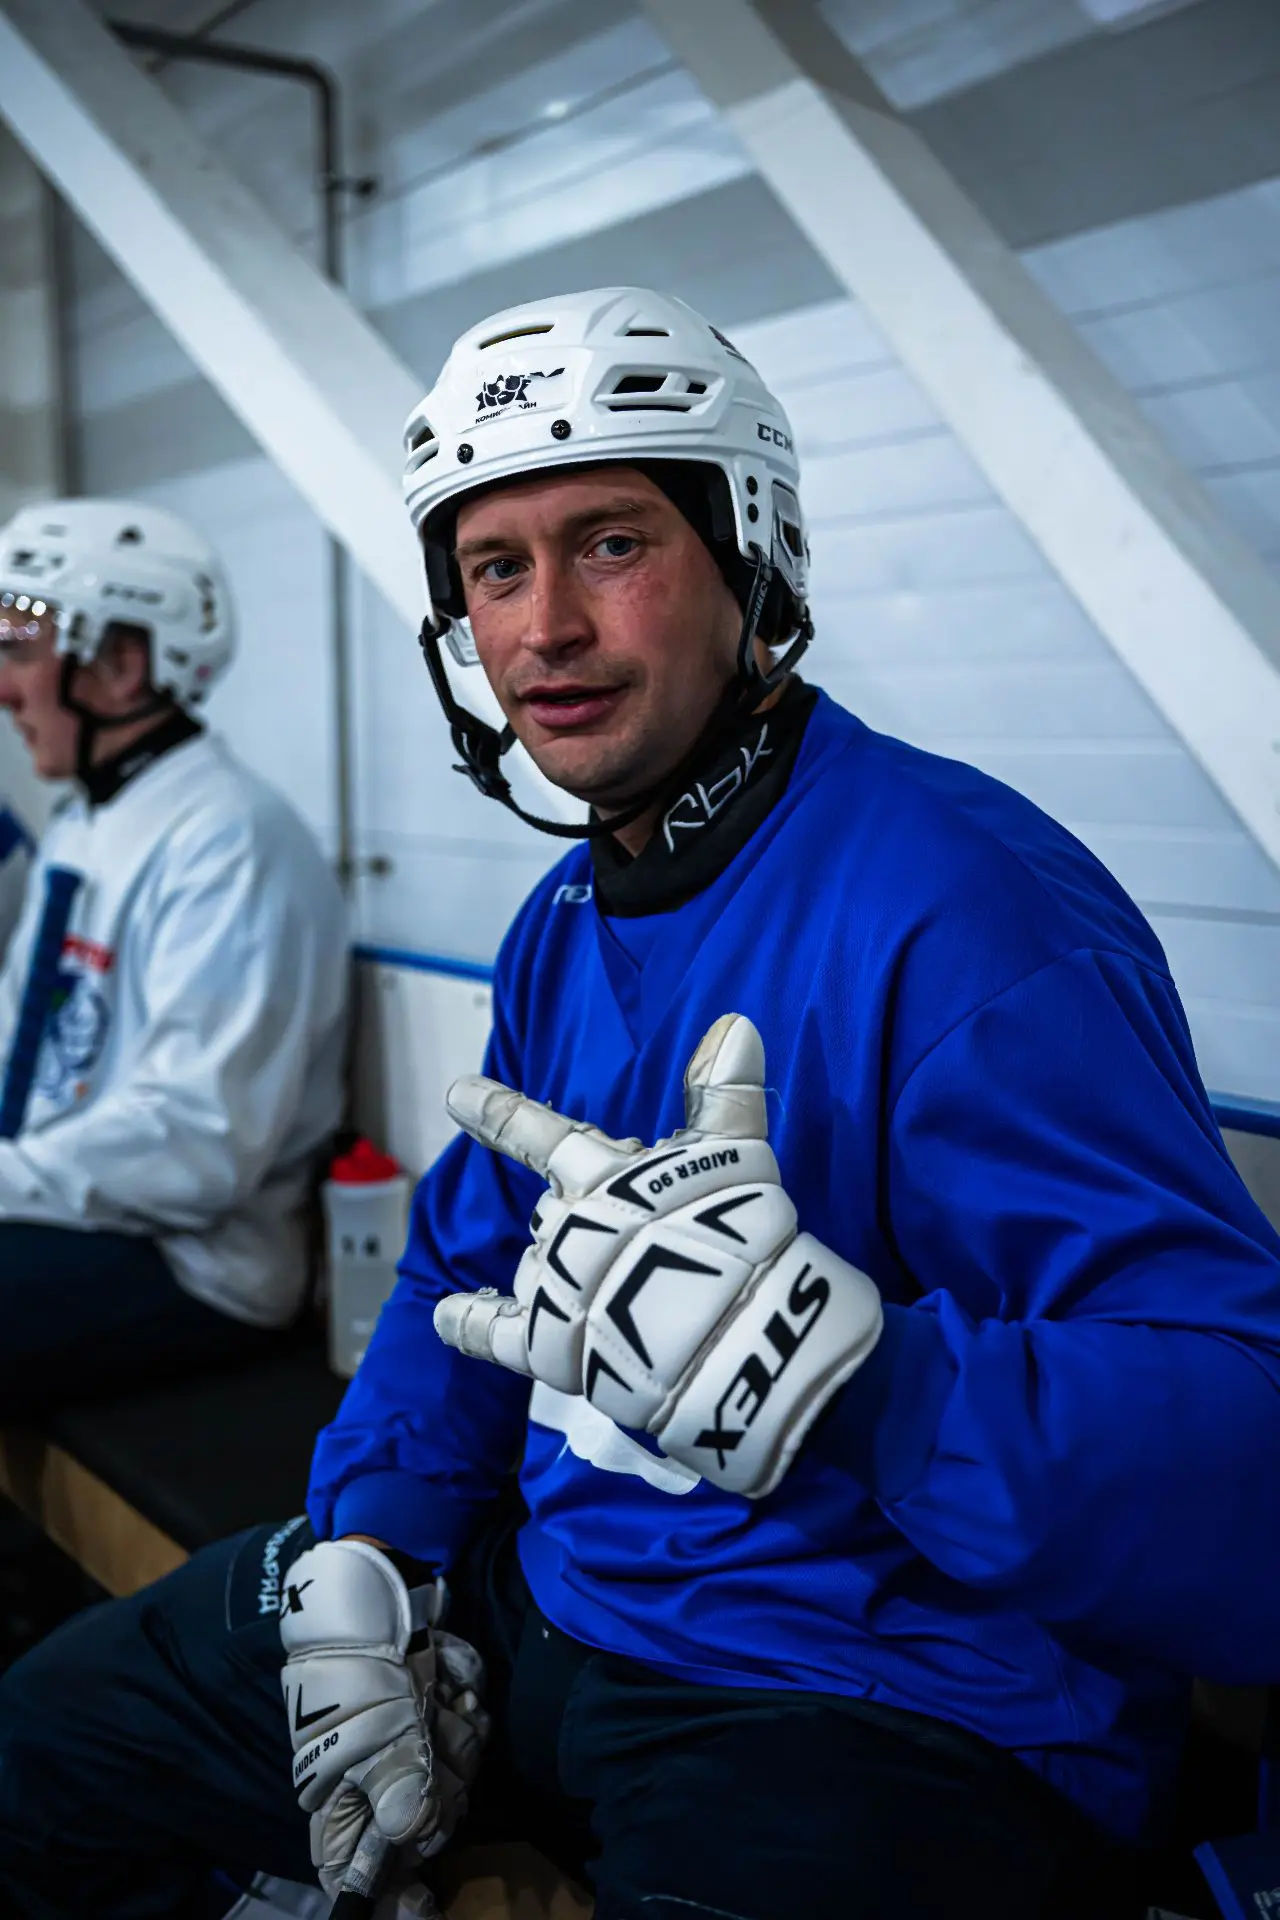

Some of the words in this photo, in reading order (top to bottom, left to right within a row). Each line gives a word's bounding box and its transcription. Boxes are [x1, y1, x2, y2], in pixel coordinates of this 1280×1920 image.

[675, 1148, 740, 1179] RAIDER
[648, 1172, 674, 1194] 90
[692, 1262, 831, 1471] STEX
[323, 1732, 339, 1752] 90
